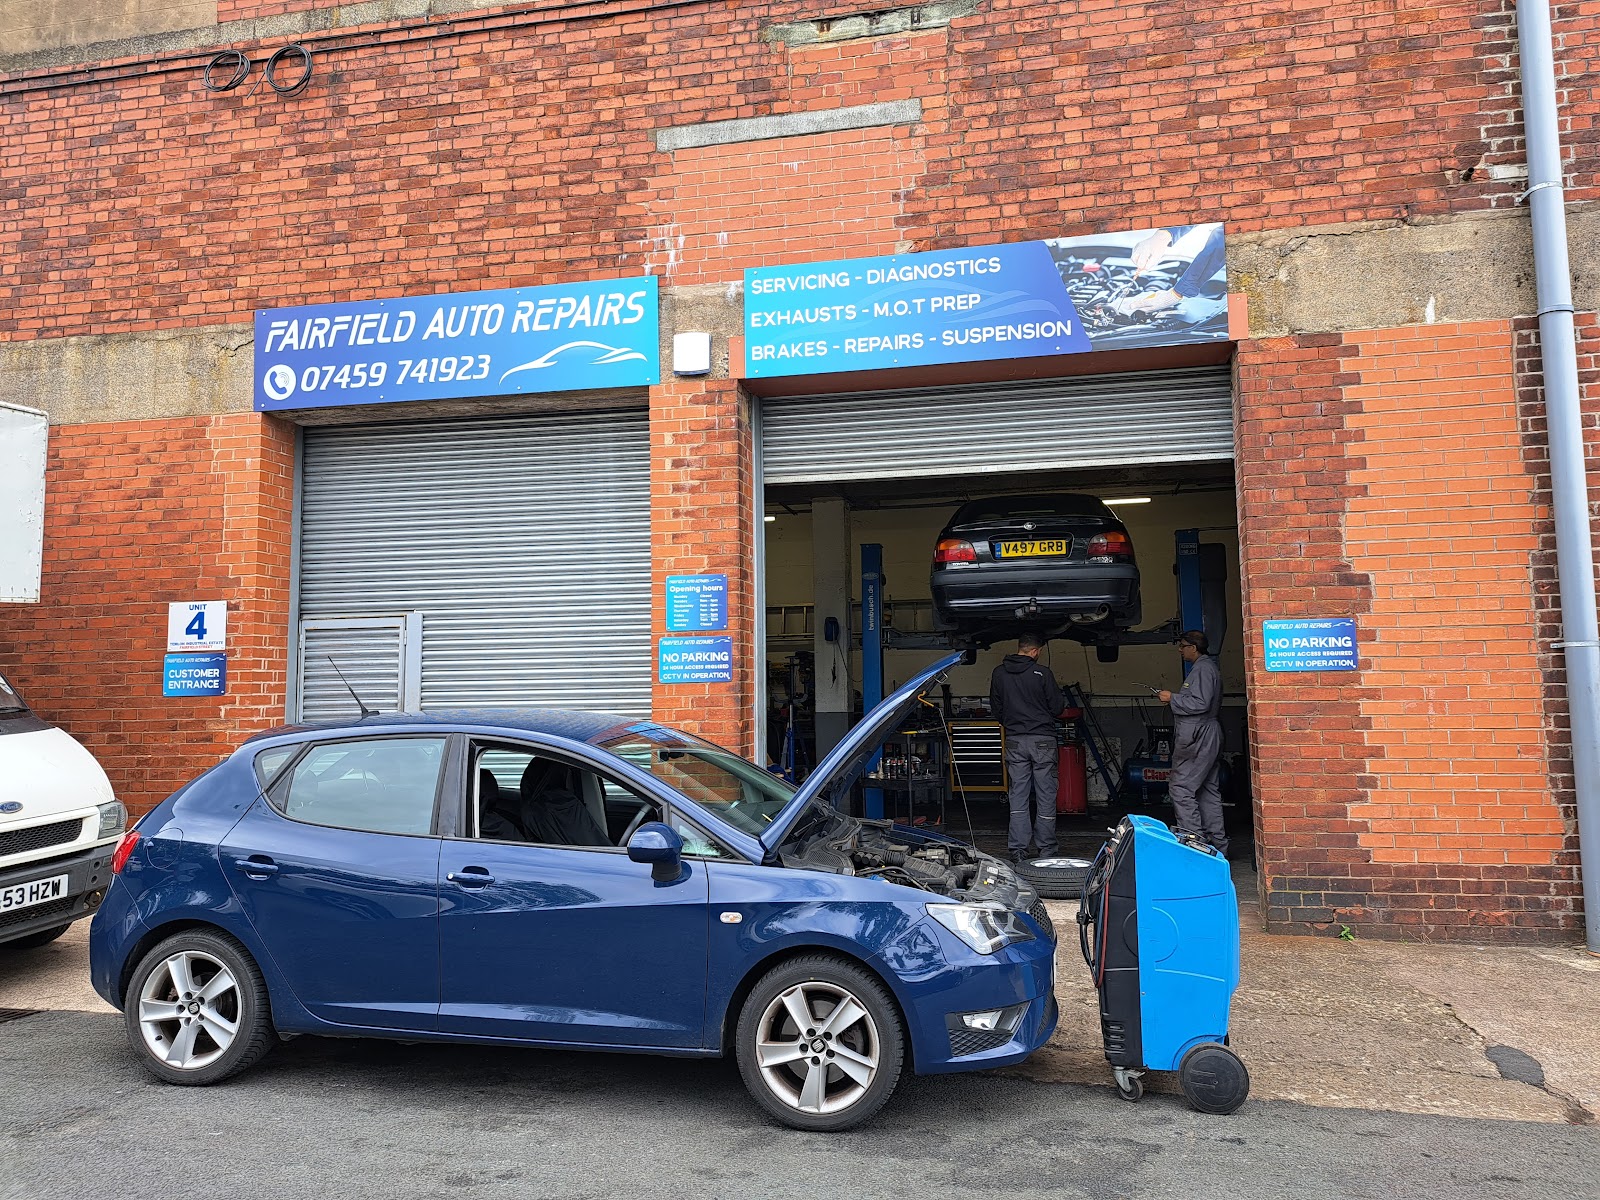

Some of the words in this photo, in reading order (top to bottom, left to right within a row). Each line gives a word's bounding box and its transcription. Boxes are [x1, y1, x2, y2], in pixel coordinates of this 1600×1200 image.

[751, 271, 850, 295] SERVICING
[867, 257, 1001, 285] DIAGNOSTICS
[751, 304, 857, 328] EXHAUSTS
[874, 298, 926, 318] M.O.T
[931, 294, 981, 312] PREP
[265, 310, 416, 353] FAIRFIELD
[423, 303, 502, 340] AUTO
[511, 291, 647, 333] REPAIRS
[751, 340, 828, 361] BRAKES
[844, 332, 924, 354] REPAIRS
[942, 320, 1072, 346] SUSPENSION
[301, 361, 387, 393] 07459
[396, 354, 490, 385] 741923
[1003, 542, 1036, 554] V497
[1039, 541, 1063, 552] GRB
[185, 611, 207, 640] 4
[1269, 637, 1289, 648] NO
[1292, 636, 1353, 648] PARKING
[663, 653, 679, 663] NO
[681, 651, 729, 662] PARKING
[1305, 659, 1354, 667] OPERATION
[168, 668, 220, 679] CUSTOMER
[168, 679, 220, 690] ENTRANCE
[1143, 768, 1172, 781] Clar
[0, 887, 25, 908] 53
[29, 879, 61, 903] HZW
